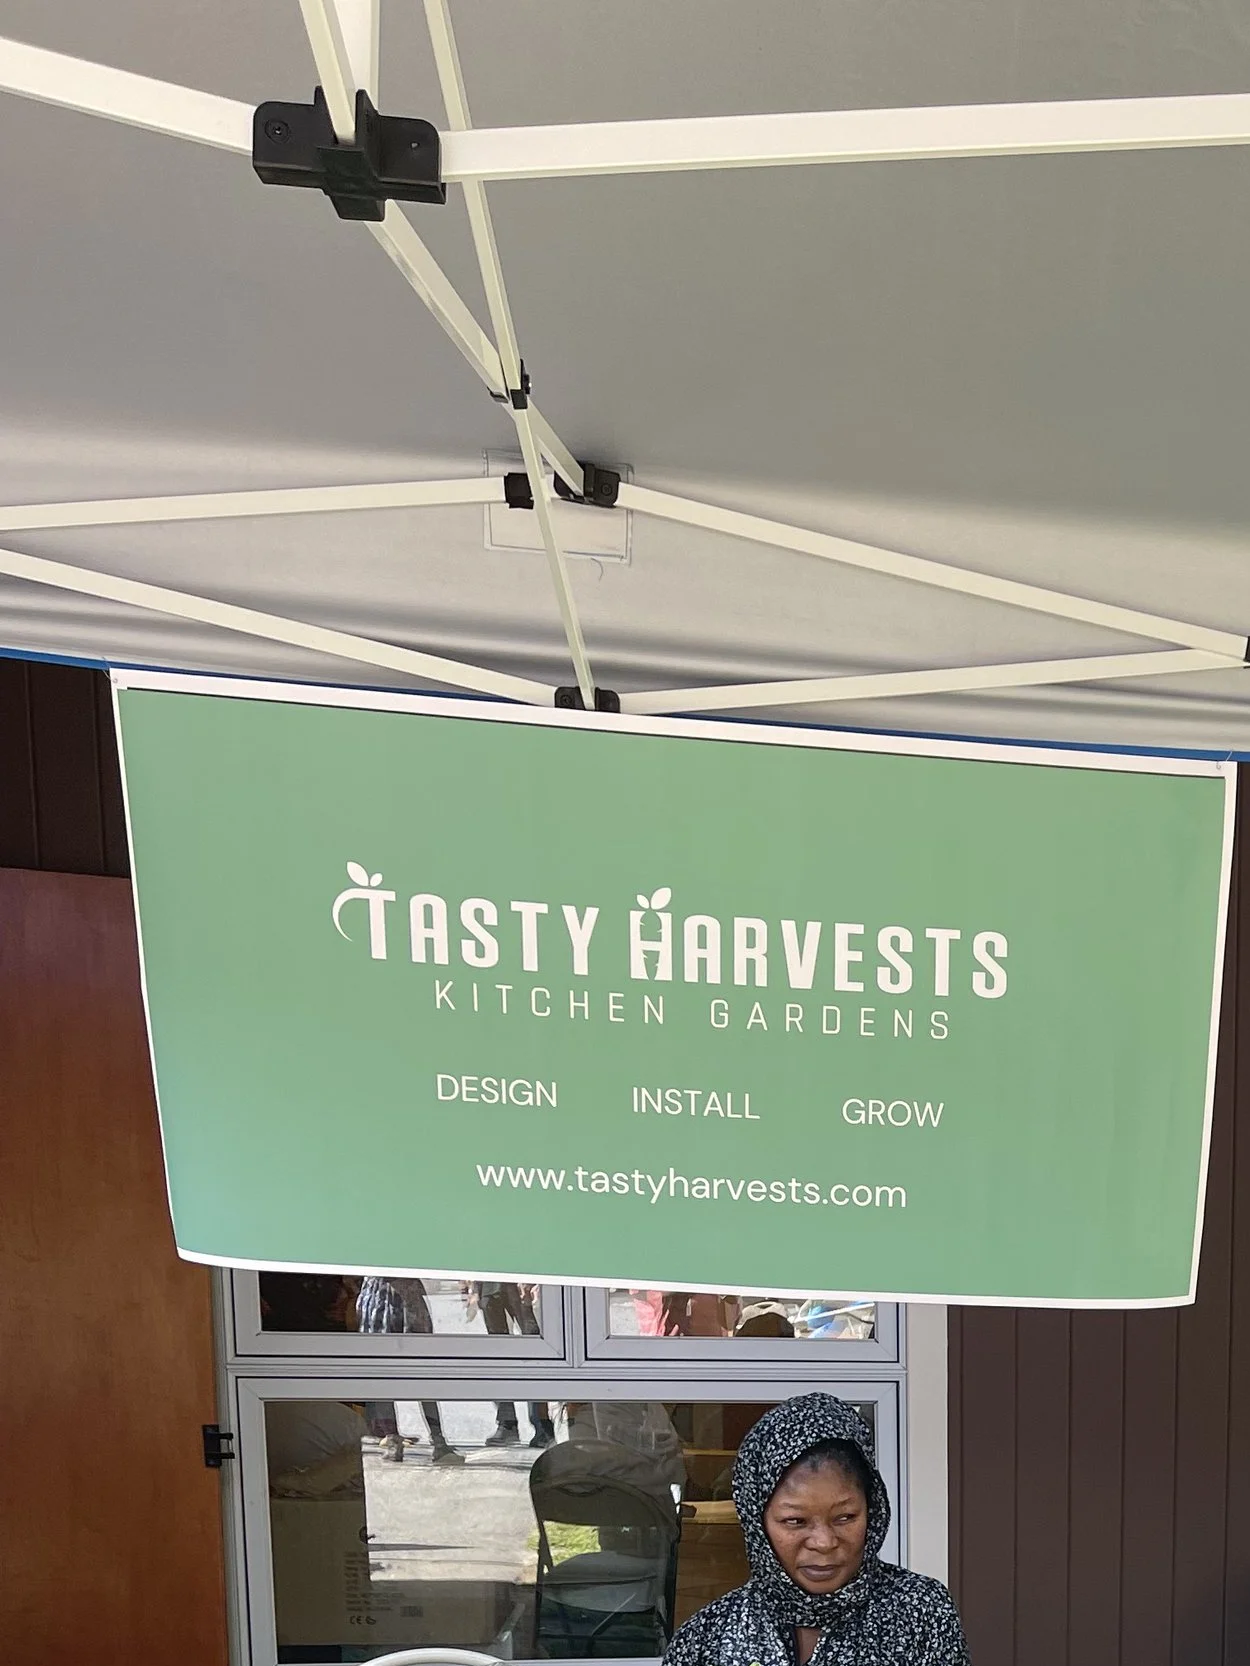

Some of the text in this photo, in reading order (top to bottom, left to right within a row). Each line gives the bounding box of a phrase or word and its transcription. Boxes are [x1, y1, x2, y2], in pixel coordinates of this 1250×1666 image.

[332, 886, 1009, 999] TASTY HARVESTS
[434, 979, 950, 1039] KITCHEN GARDENS
[436, 1074, 945, 1128] DESIGN INSTALL GROW
[476, 1164, 908, 1208] www.tastyharvests.com
